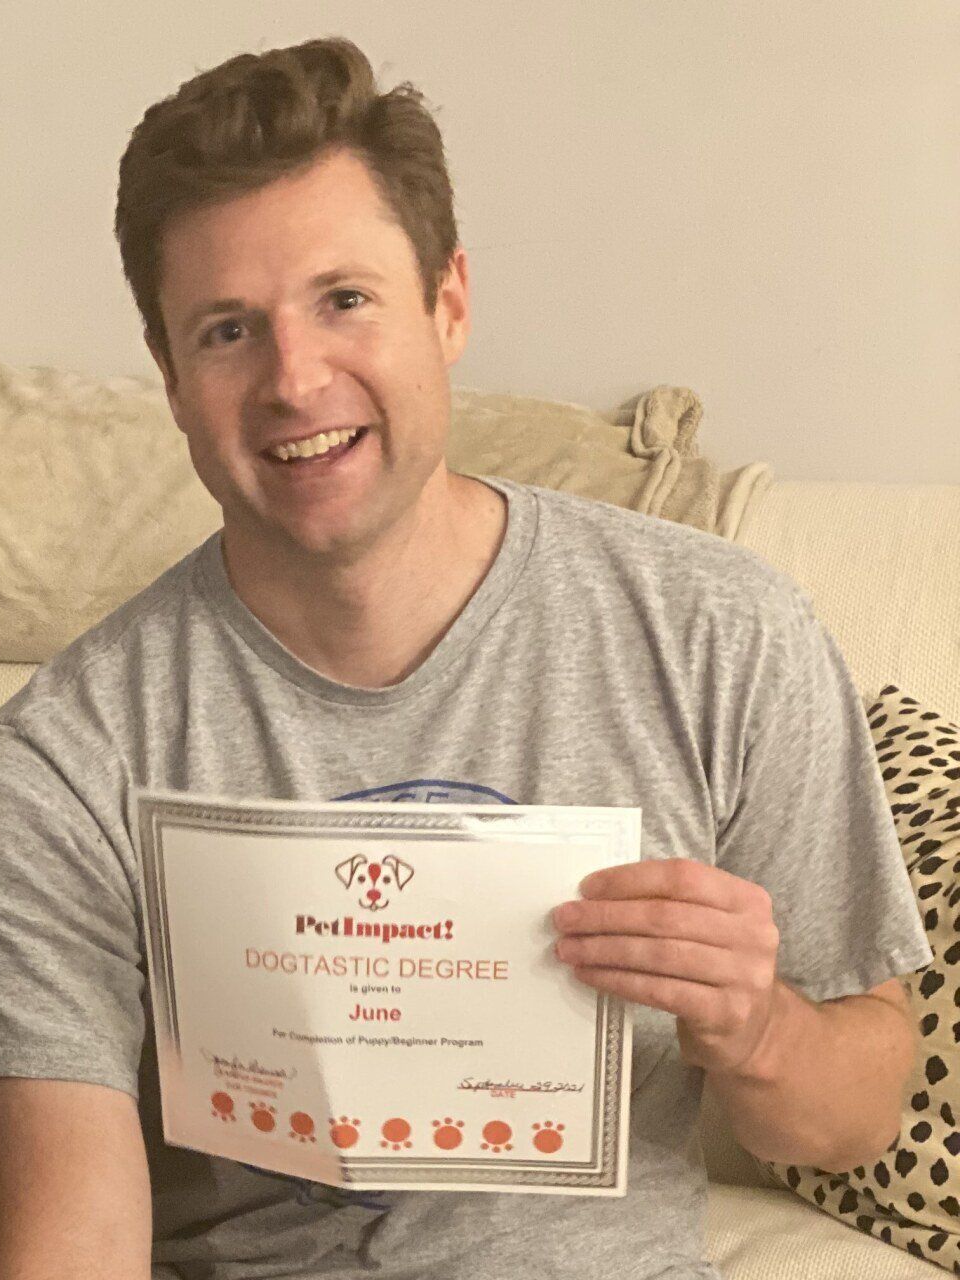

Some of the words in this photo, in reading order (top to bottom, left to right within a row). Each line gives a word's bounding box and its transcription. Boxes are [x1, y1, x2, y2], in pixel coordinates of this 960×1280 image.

[295, 914, 454, 944] PetImpact!
[244, 947, 390, 978] DOGTASTIC
[399, 958, 509, 980] DEGREE
[349, 984, 359, 993] is
[361, 984, 389, 995] given
[390, 985, 402, 994] to
[348, 1003, 402, 1022] June
[346, 1035, 357, 1045] of
[440, 1037, 484, 1048] Program
